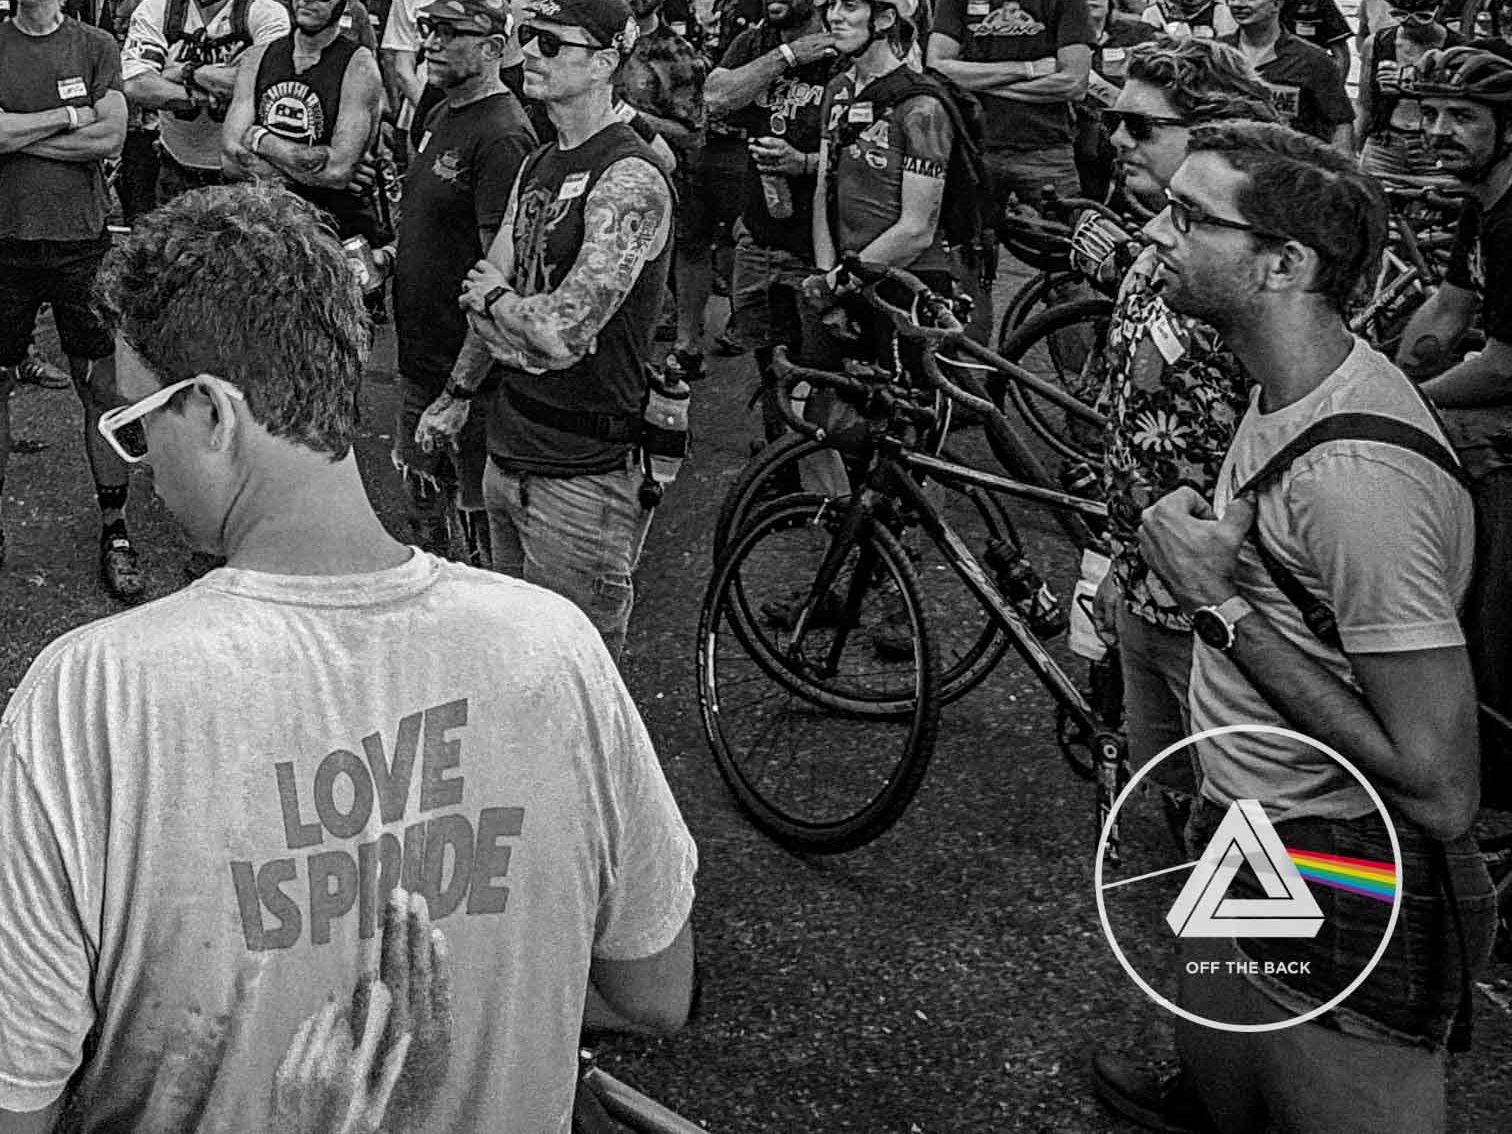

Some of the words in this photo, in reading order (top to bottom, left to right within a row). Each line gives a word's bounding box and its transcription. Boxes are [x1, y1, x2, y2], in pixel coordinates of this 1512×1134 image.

[274, 697, 469, 849] LOVE
[229, 857, 303, 952] IS
[306, 805, 526, 946] PRIDE
